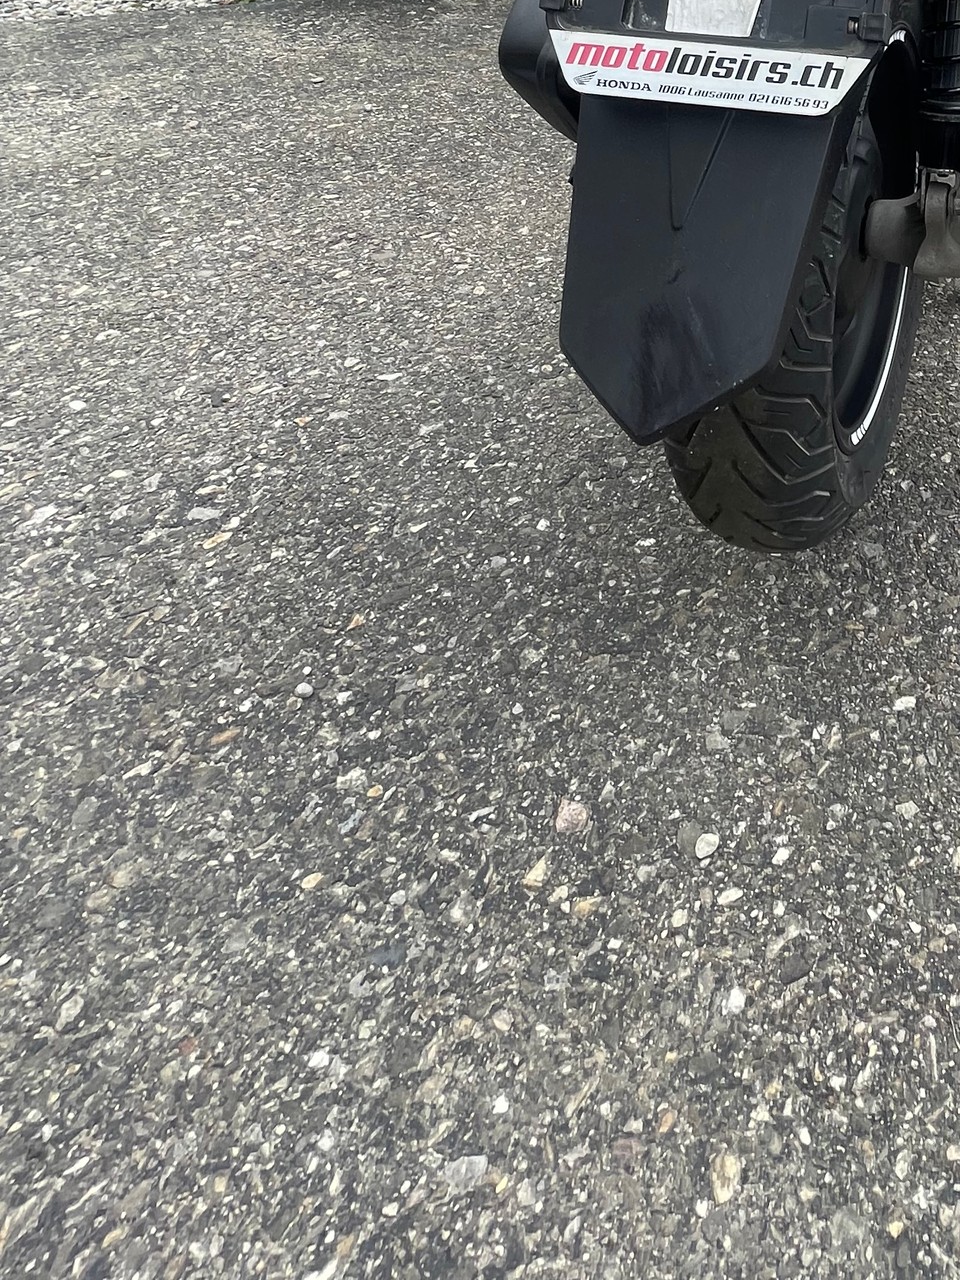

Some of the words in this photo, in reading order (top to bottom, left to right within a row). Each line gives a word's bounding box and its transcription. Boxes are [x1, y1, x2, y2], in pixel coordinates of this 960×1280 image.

[565, 42, 845, 90] motoloisirs.ch
[596, 78, 652, 92] HONDA
[658, 84, 687, 96] 1006
[687, 87, 745, 102] Lausanne
[748, 93, 770, 104] 021
[771, 96, 793, 106] 616
[794, 98, 811, 108] 56
[812, 100, 829, 110] 93
